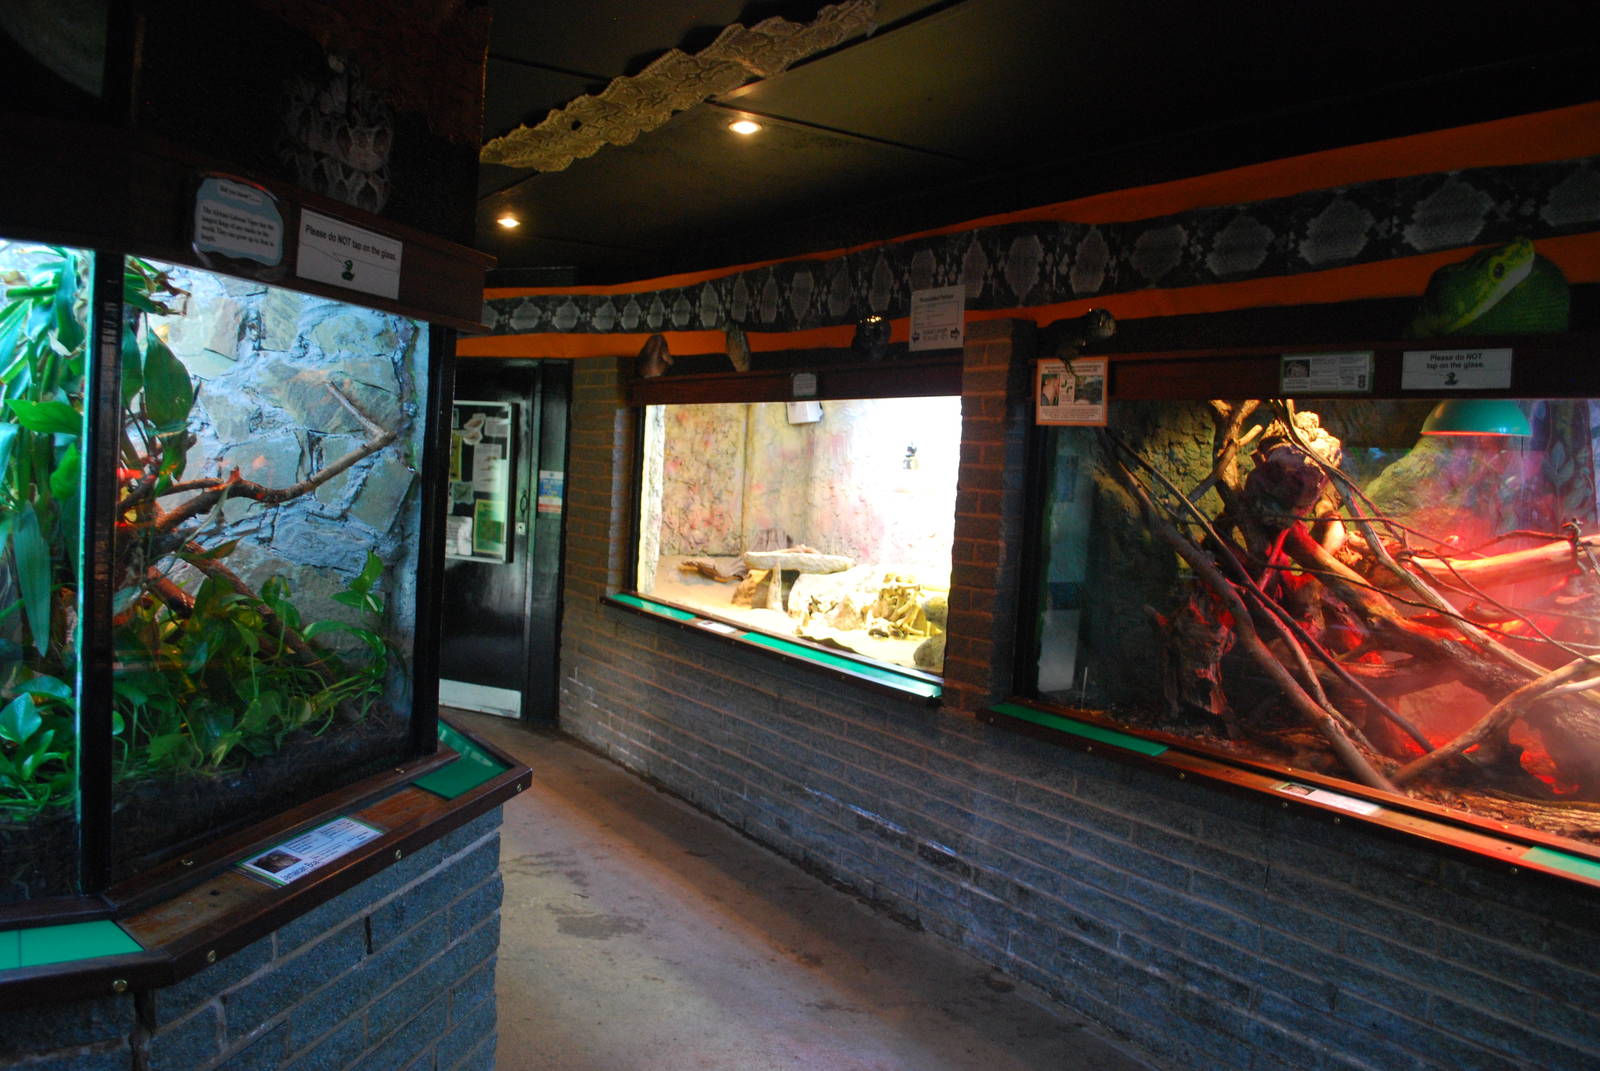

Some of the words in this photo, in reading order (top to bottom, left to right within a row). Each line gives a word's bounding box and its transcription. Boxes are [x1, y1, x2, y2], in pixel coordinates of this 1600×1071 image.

[305, 224, 327, 239] Please
[328, 231, 337, 243] do
[338, 234, 351, 246] NOT
[352, 239, 362, 251] tap
[362, 243, 371, 253] on
[371, 245, 381, 256] the
[1429, 351, 1454, 362] Please
[1455, 351, 1465, 361] do
[1466, 351, 1483, 361] NOT
[1426, 362, 1438, 371] tap
[1438, 362, 1449, 370] on
[1450, 361, 1462, 370] the
